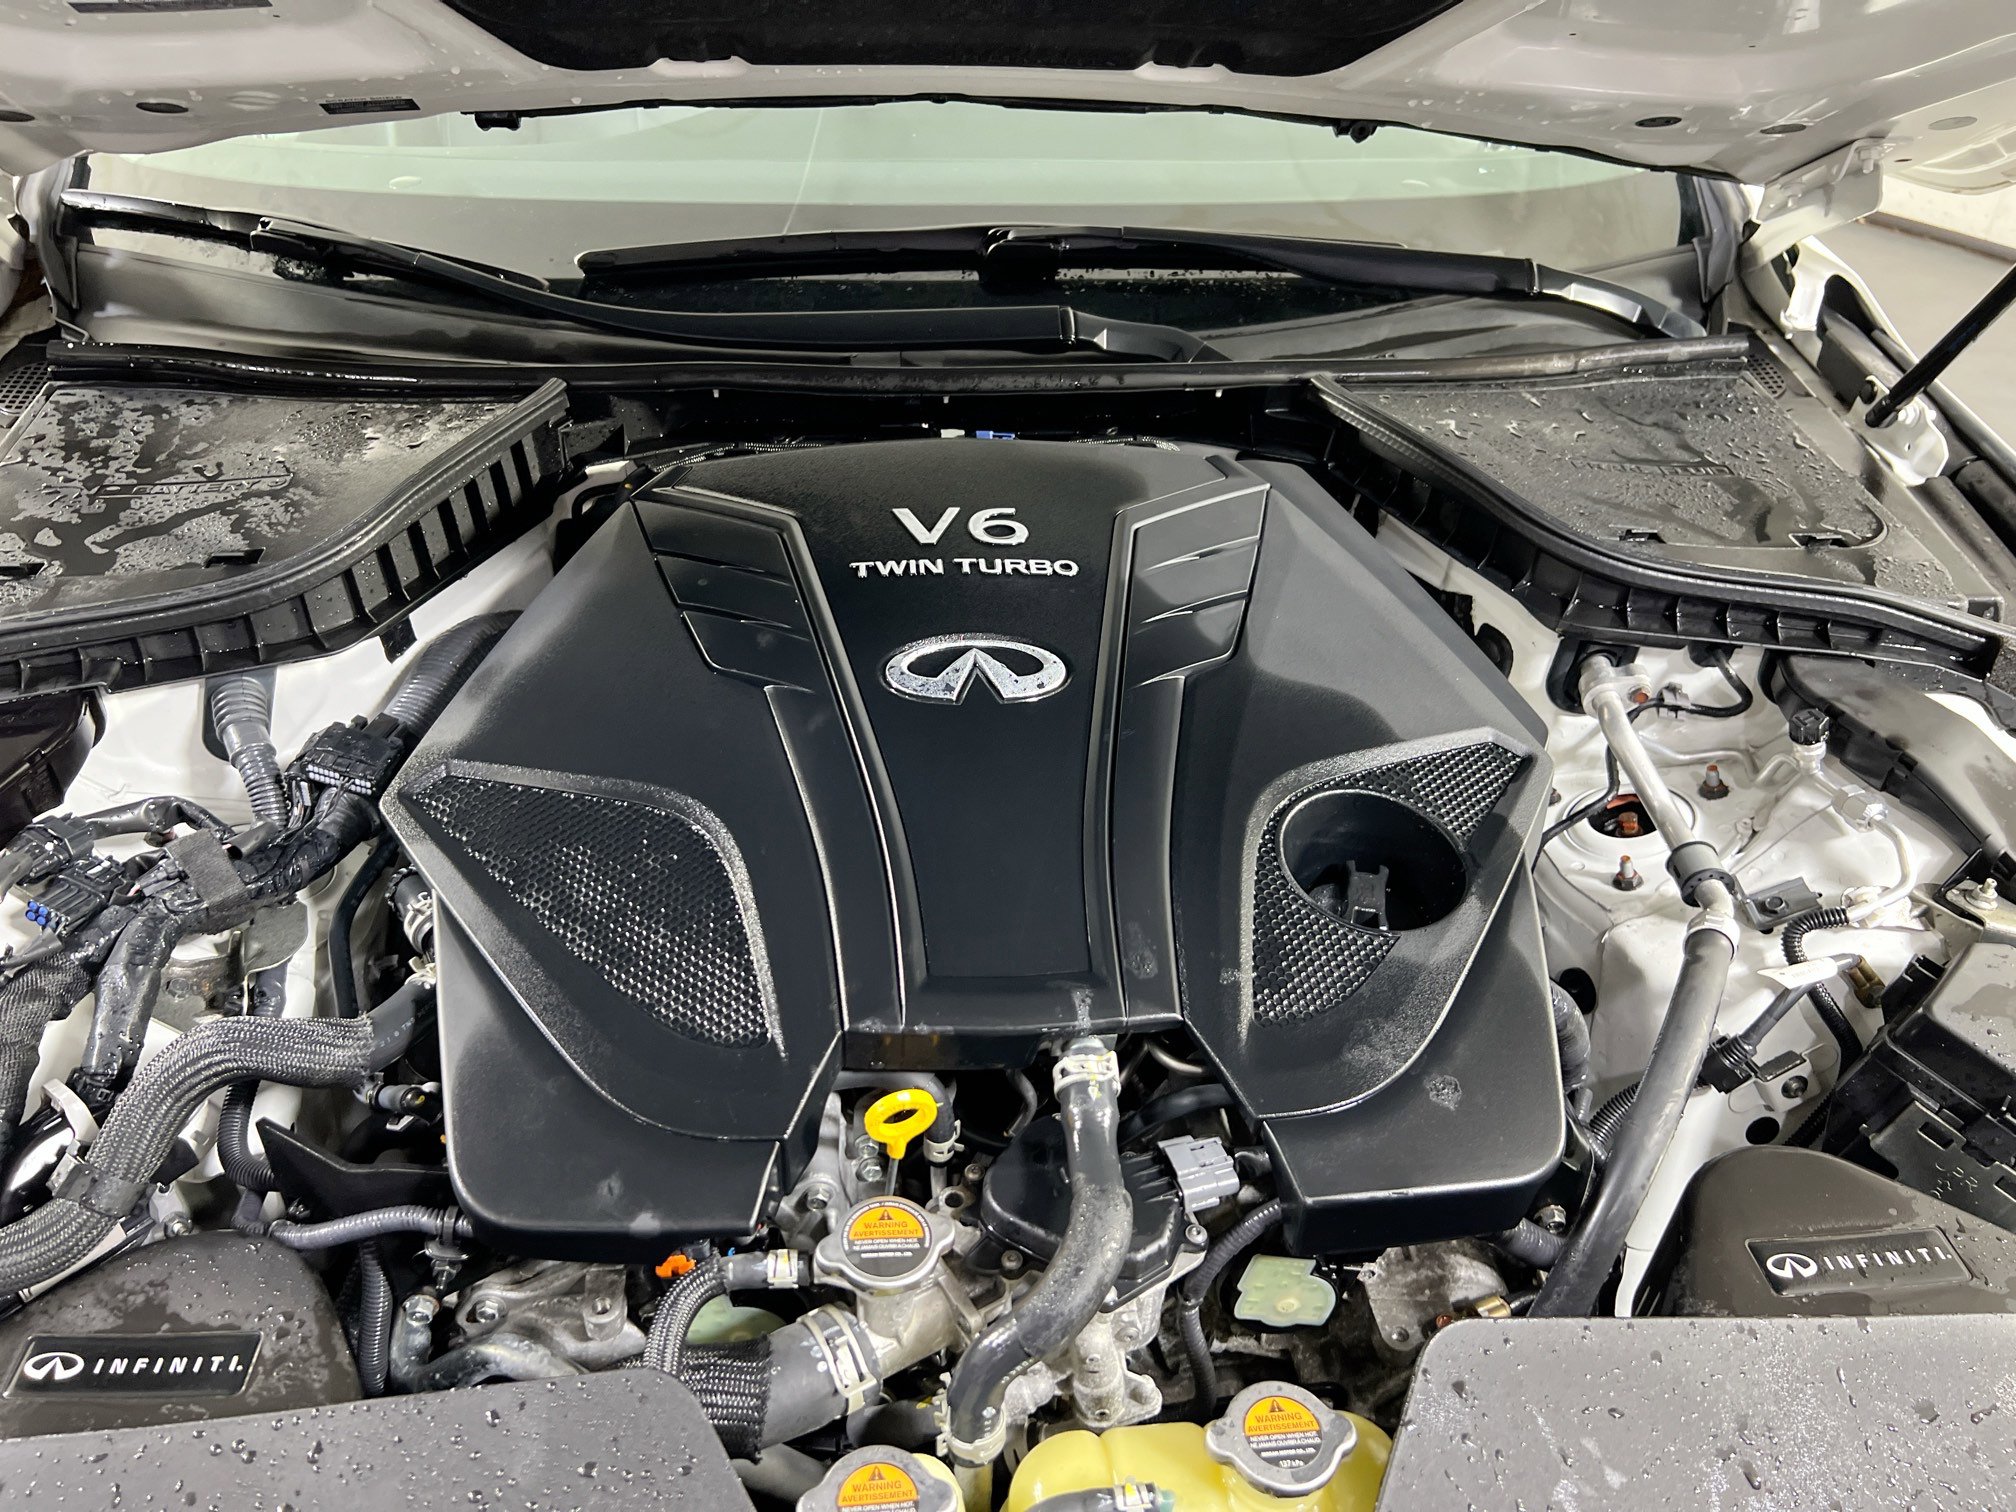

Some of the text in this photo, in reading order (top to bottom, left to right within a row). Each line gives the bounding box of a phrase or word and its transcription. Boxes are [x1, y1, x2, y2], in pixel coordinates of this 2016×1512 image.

[892, 507, 1029, 545] V6
[850, 558, 1080, 578] TWIN TURBO
[864, 1221, 908, 1229] WARNING
[853, 1229, 919, 1237] AVERTISSEMENT
[1823, 1246, 1948, 1271] INFINITI
[93, 1355, 241, 1375] INFINITI
[1255, 1412, 1302, 1424] WARNING
[1248, 1421, 1315, 1433] AVERTISSEMENT
[853, 1481, 902, 1492] WARNING
[842, 1490, 914, 1503] AVERTISSEMENT
